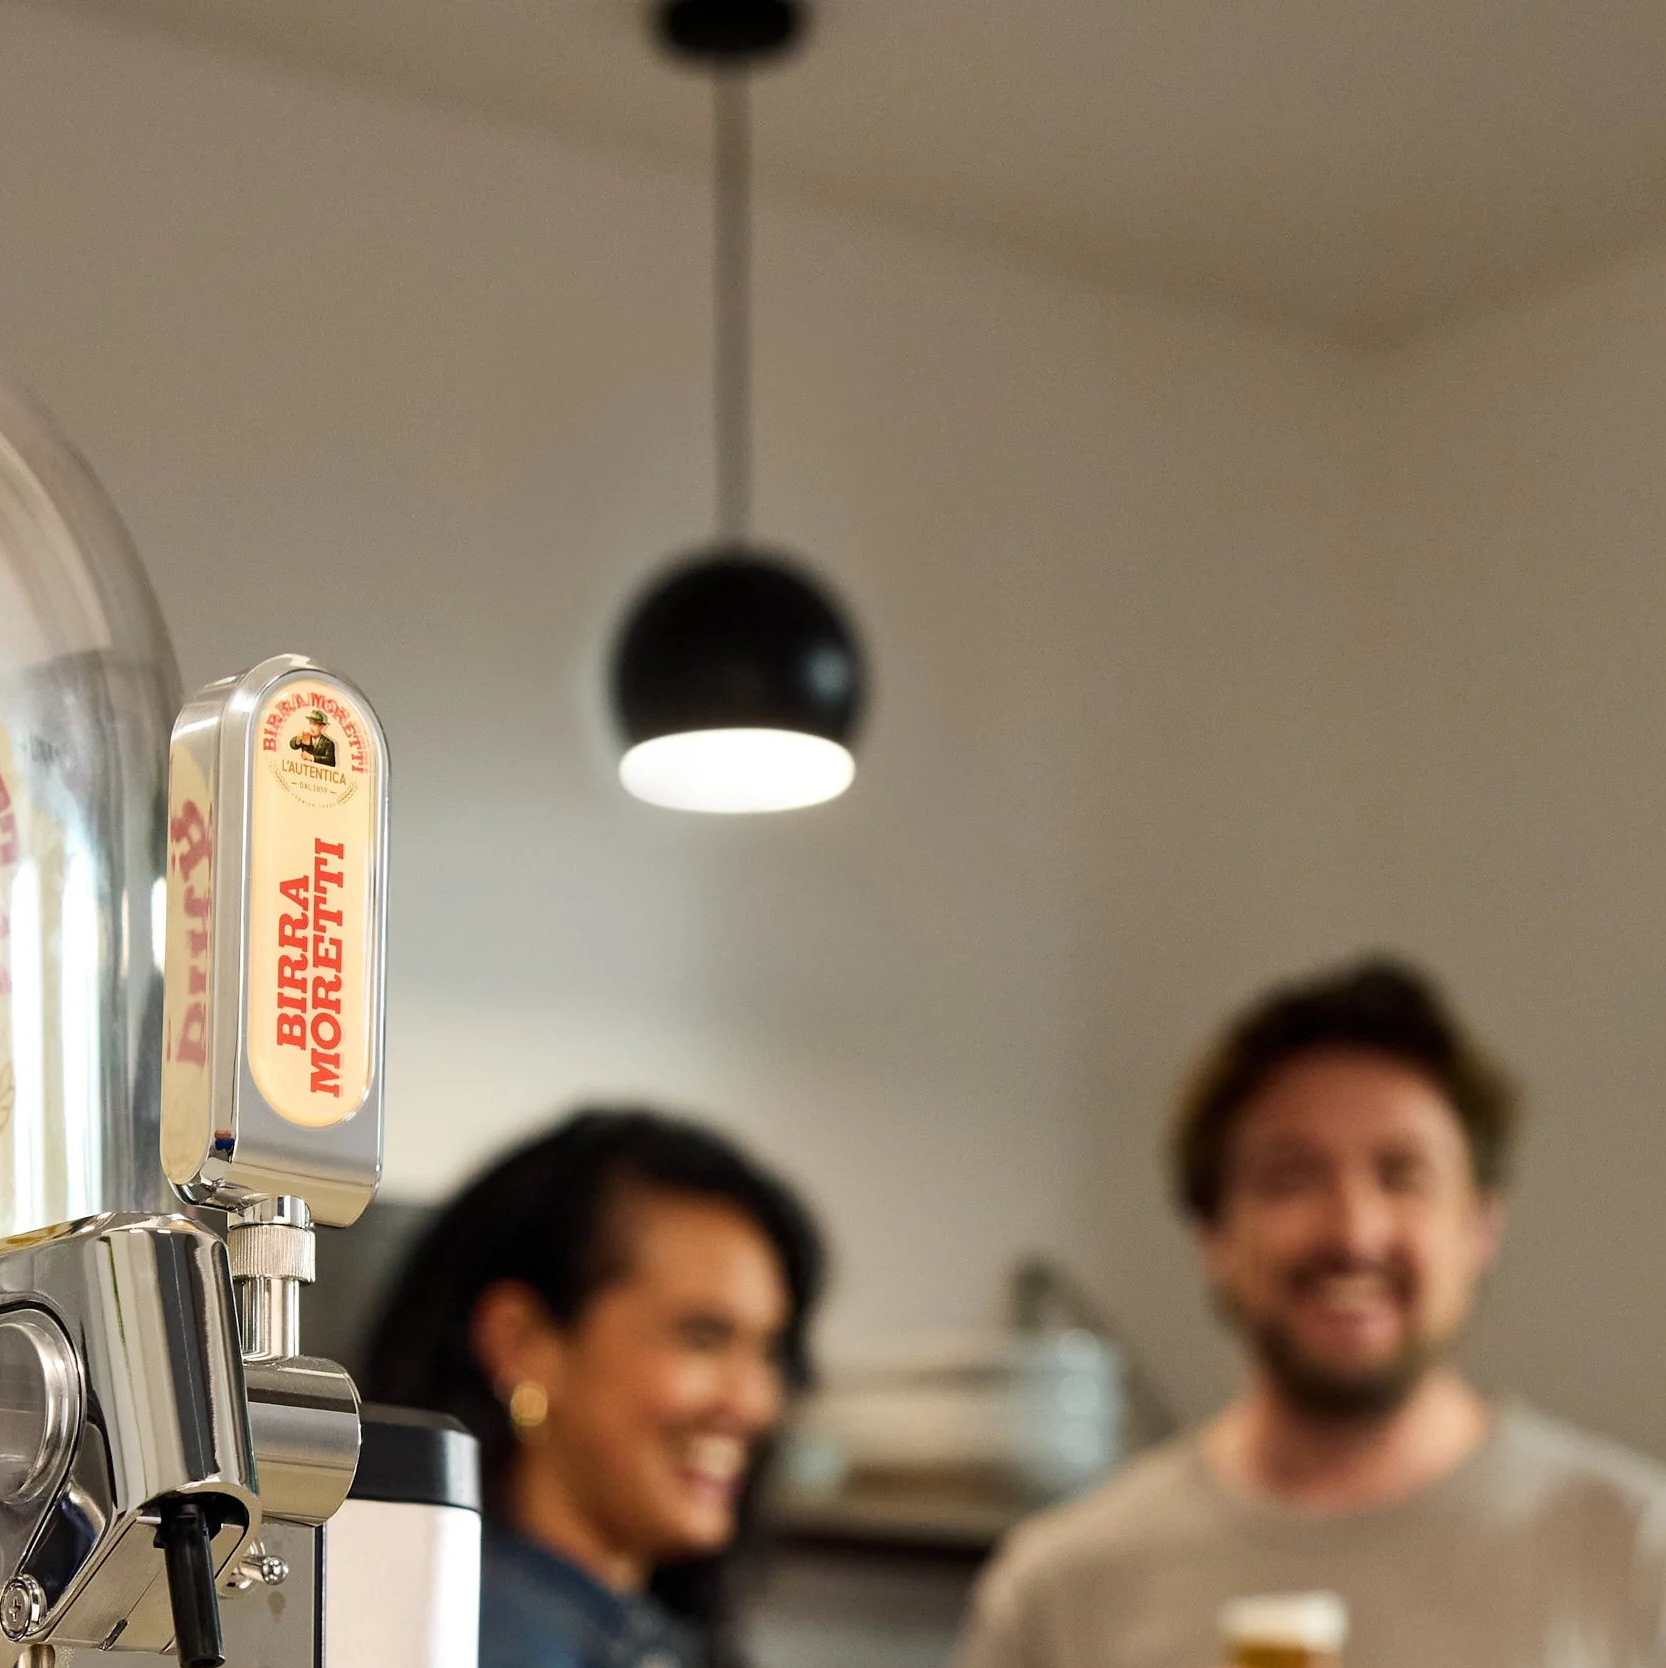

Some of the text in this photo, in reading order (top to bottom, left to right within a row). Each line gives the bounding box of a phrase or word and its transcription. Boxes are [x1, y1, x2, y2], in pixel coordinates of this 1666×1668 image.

[263, 692, 368, 774] BIRRA MORETTI
[282, 759, 347, 785] L'AUTENTICA
[276, 875, 309, 1051] BIRRA
[309, 837, 345, 1098] MORETTI
